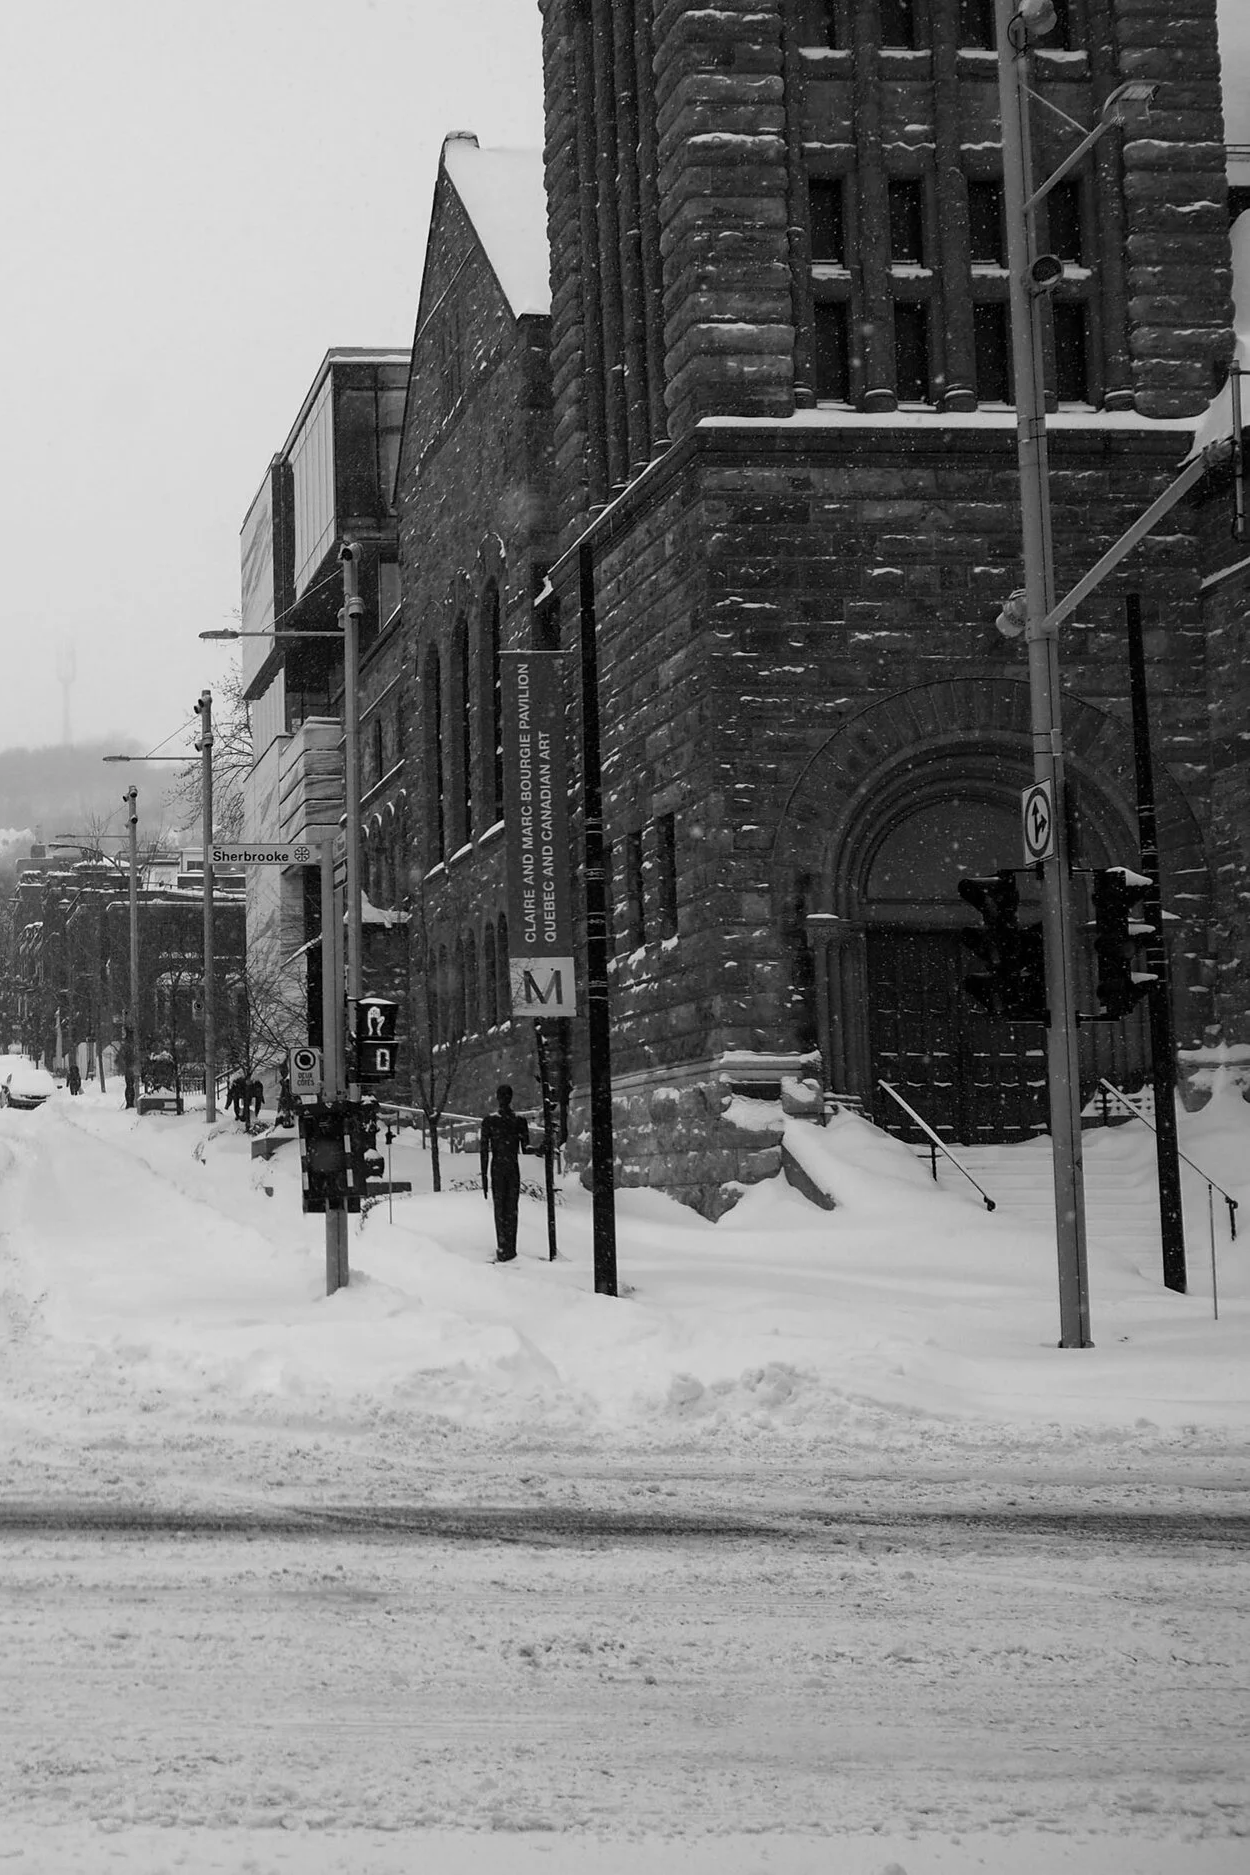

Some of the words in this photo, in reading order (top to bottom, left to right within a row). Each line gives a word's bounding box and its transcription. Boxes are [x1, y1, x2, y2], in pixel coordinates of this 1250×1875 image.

[516, 663, 531, 729] PAVILION
[518, 733, 532, 801] BOURGIE
[538, 731, 551, 761] ART
[539, 764, 553, 841] CANADIAN
[520, 805, 534, 849] MARC
[213, 850, 289, 862] Sherbrooke
[522, 853, 535, 885] AND
[541, 845, 554, 877] AND
[523, 889, 537, 943] CLAIRE
[543, 881, 557, 943] QUEBEC
[523, 969, 564, 1005] M
